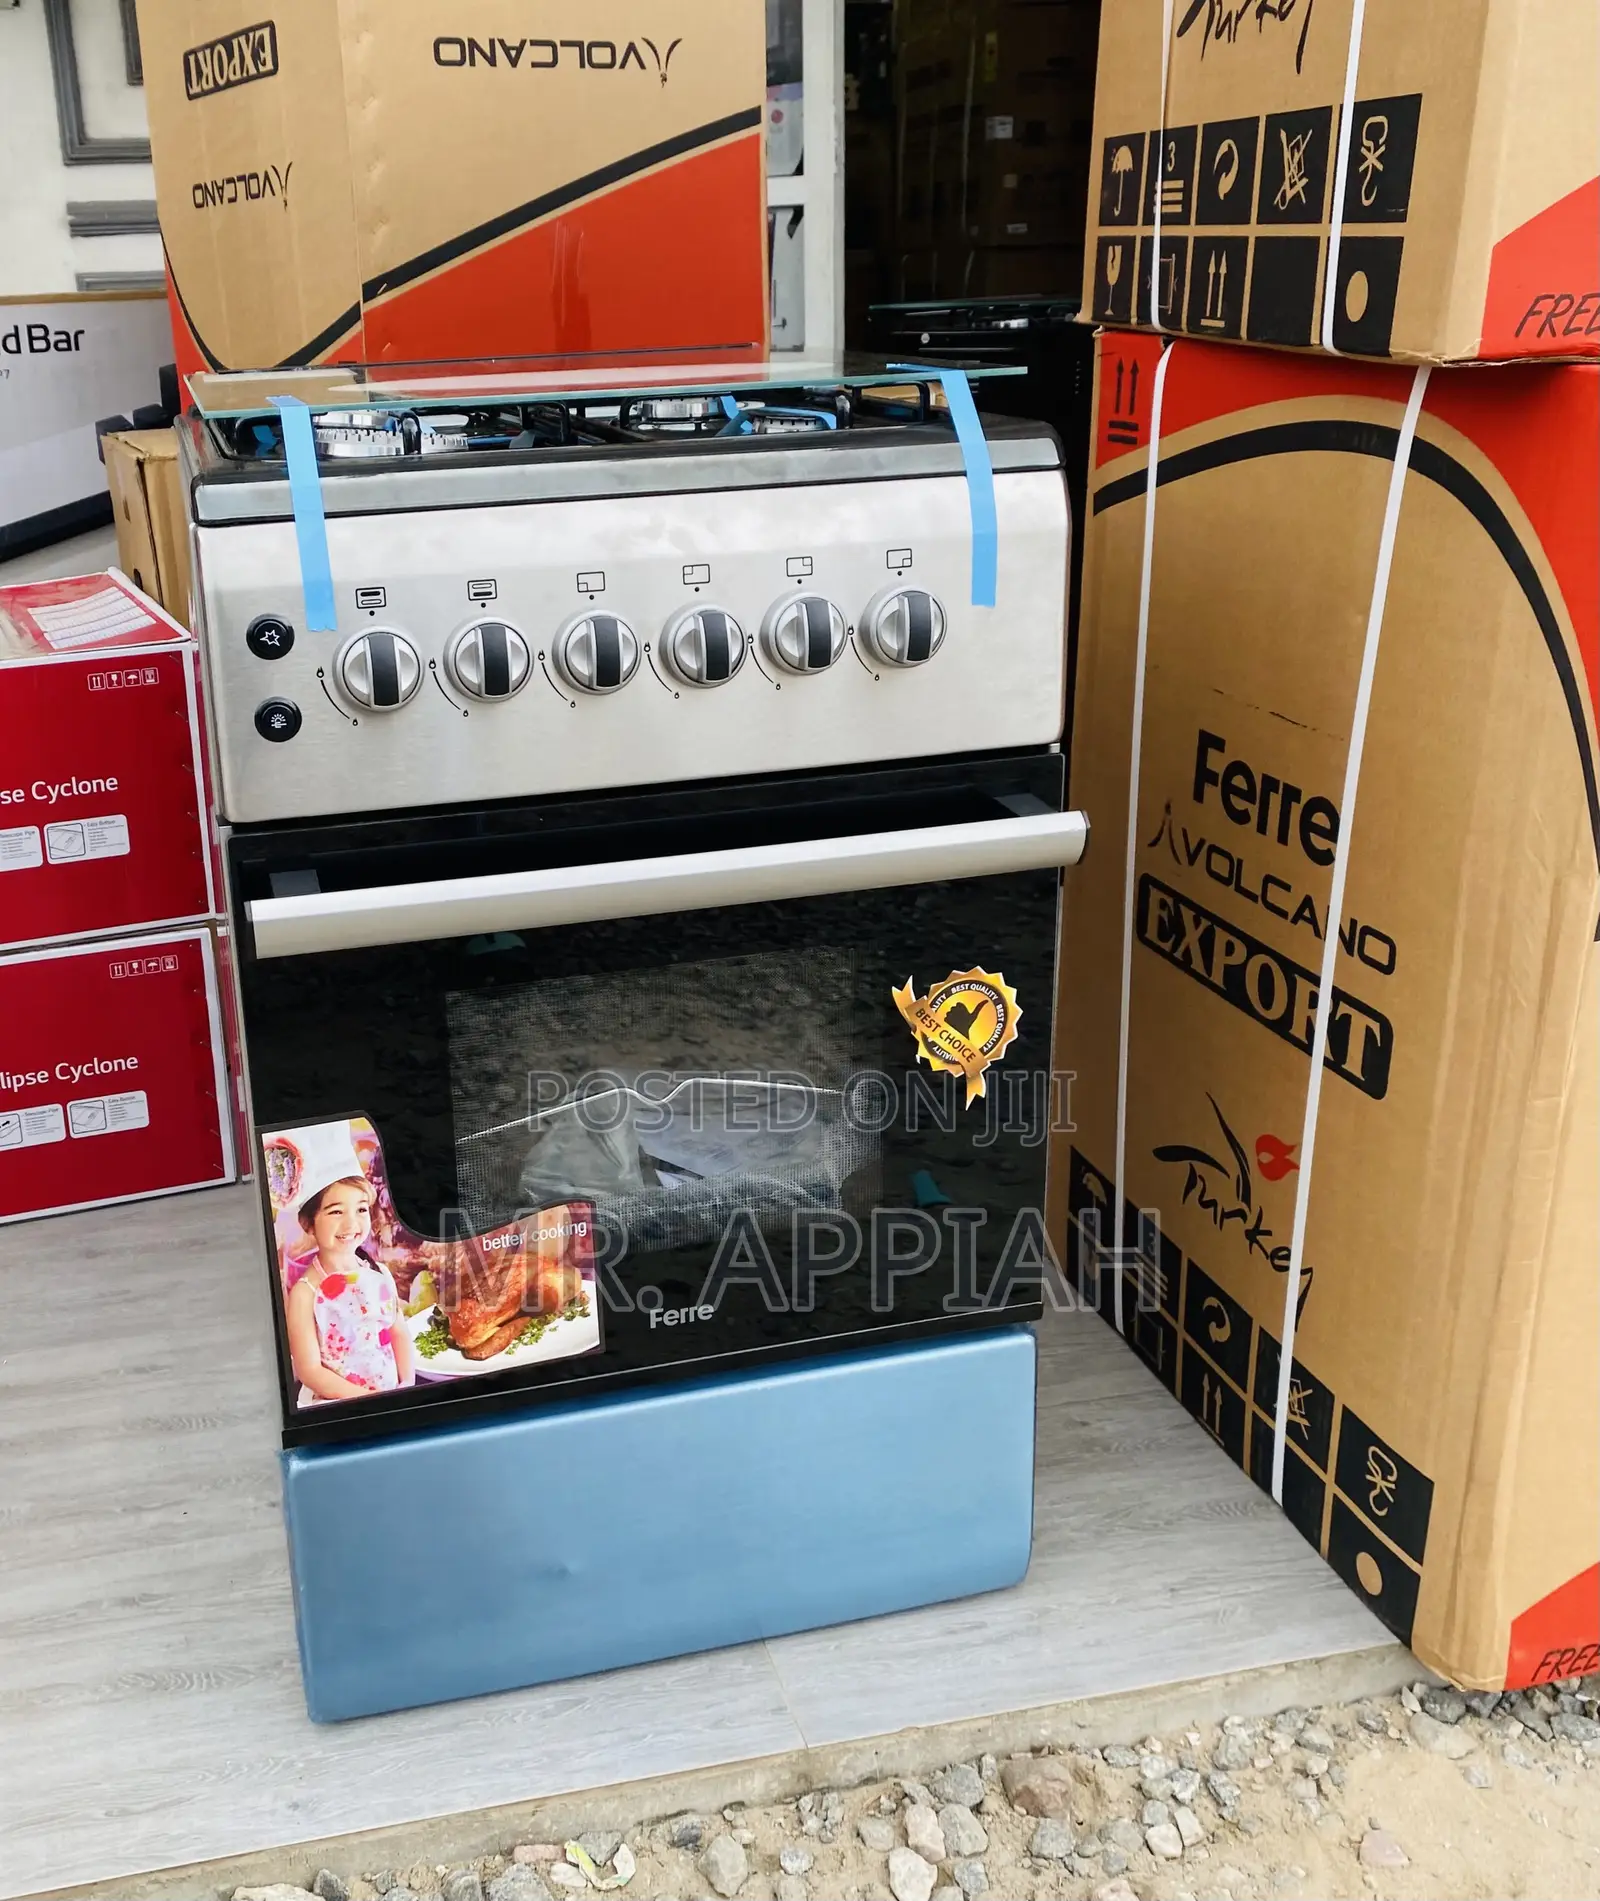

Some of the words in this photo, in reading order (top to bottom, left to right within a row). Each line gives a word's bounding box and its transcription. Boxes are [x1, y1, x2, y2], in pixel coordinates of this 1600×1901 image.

[187, 26, 275, 95] EXPORT
[433, 36, 647, 70] VOLCANO
[192, 169, 276, 209] VOLCANO
[26, 323, 85, 353] Bar
[31, 776, 119, 804] Cyclone
[1193, 728, 1341, 866] Ferre
[1181, 826, 1397, 975] VOLCANO
[950, 983, 970, 994] BEST
[970, 983, 999, 1001] QUALITY
[1144, 893, 1382, 1081] EXPORT
[996, 1003, 1005, 1023] BEST
[916, 1009, 941, 1032] BEST
[939, 1029, 976, 1063] CHOICE
[983, 1023, 1004, 1053] QUALITY
[0, 1070, 49, 1093] lipse
[55, 1056, 139, 1083] Cyclone
[482, 1233, 525, 1251] better
[531, 1219, 587, 1242] cooking
[1152, 1145, 1313, 1333] Turkey
[650, 1304, 714, 1329] Ferre
